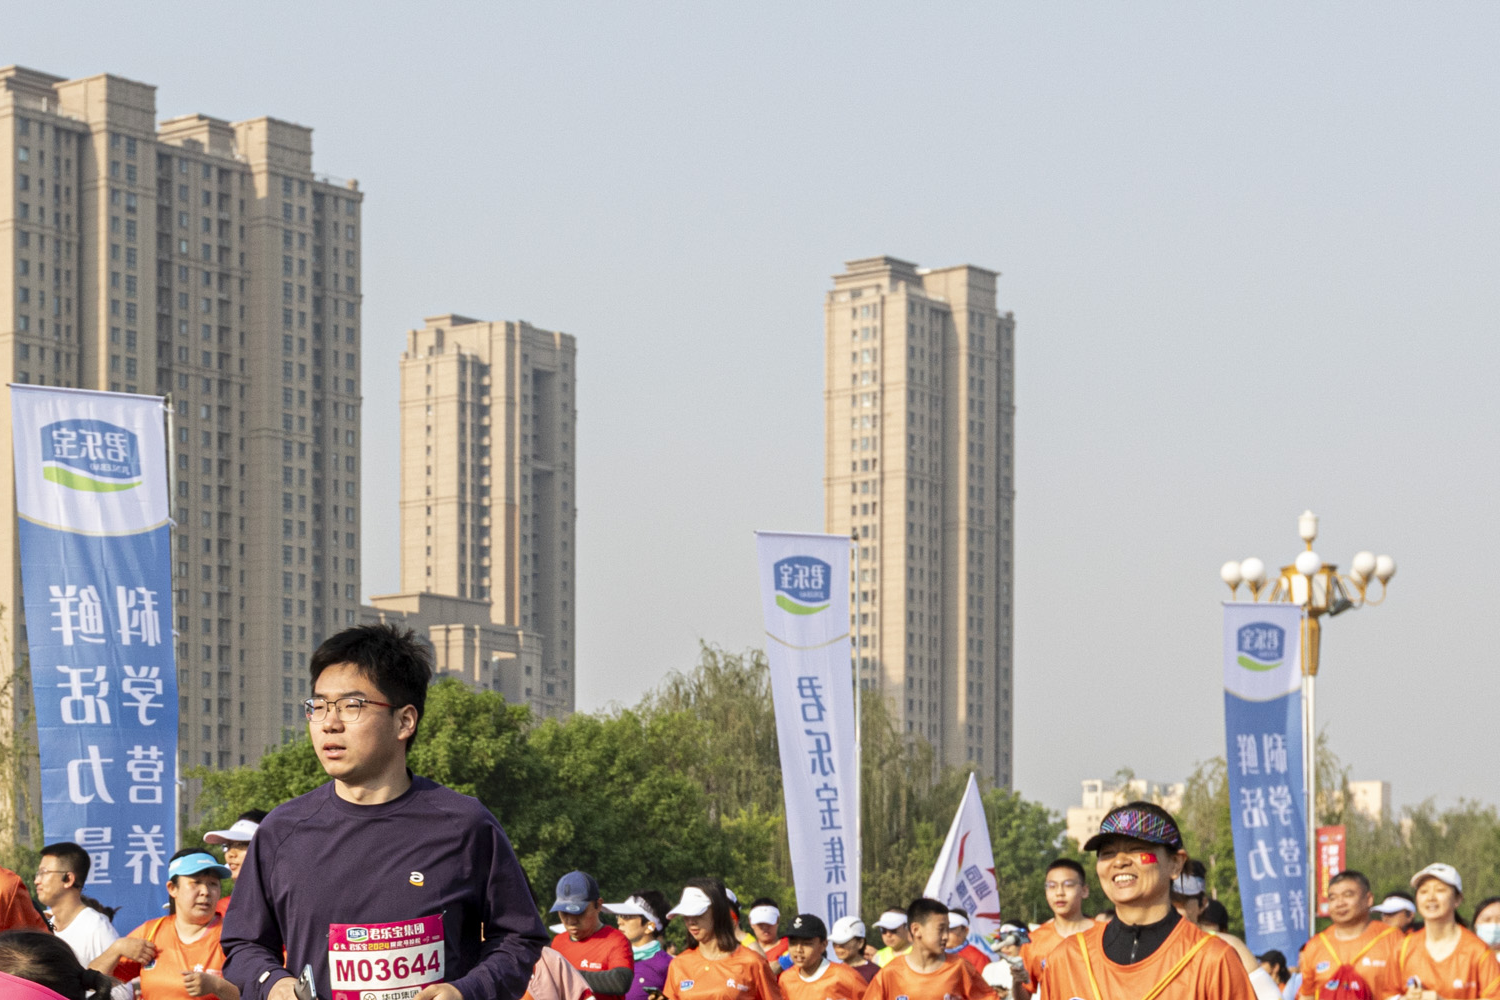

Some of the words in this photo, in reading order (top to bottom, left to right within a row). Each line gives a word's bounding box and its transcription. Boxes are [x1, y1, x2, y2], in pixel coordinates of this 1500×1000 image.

[370, 923, 425, 940] 君乐宝集团
[336, 950, 440, 982] M03644
